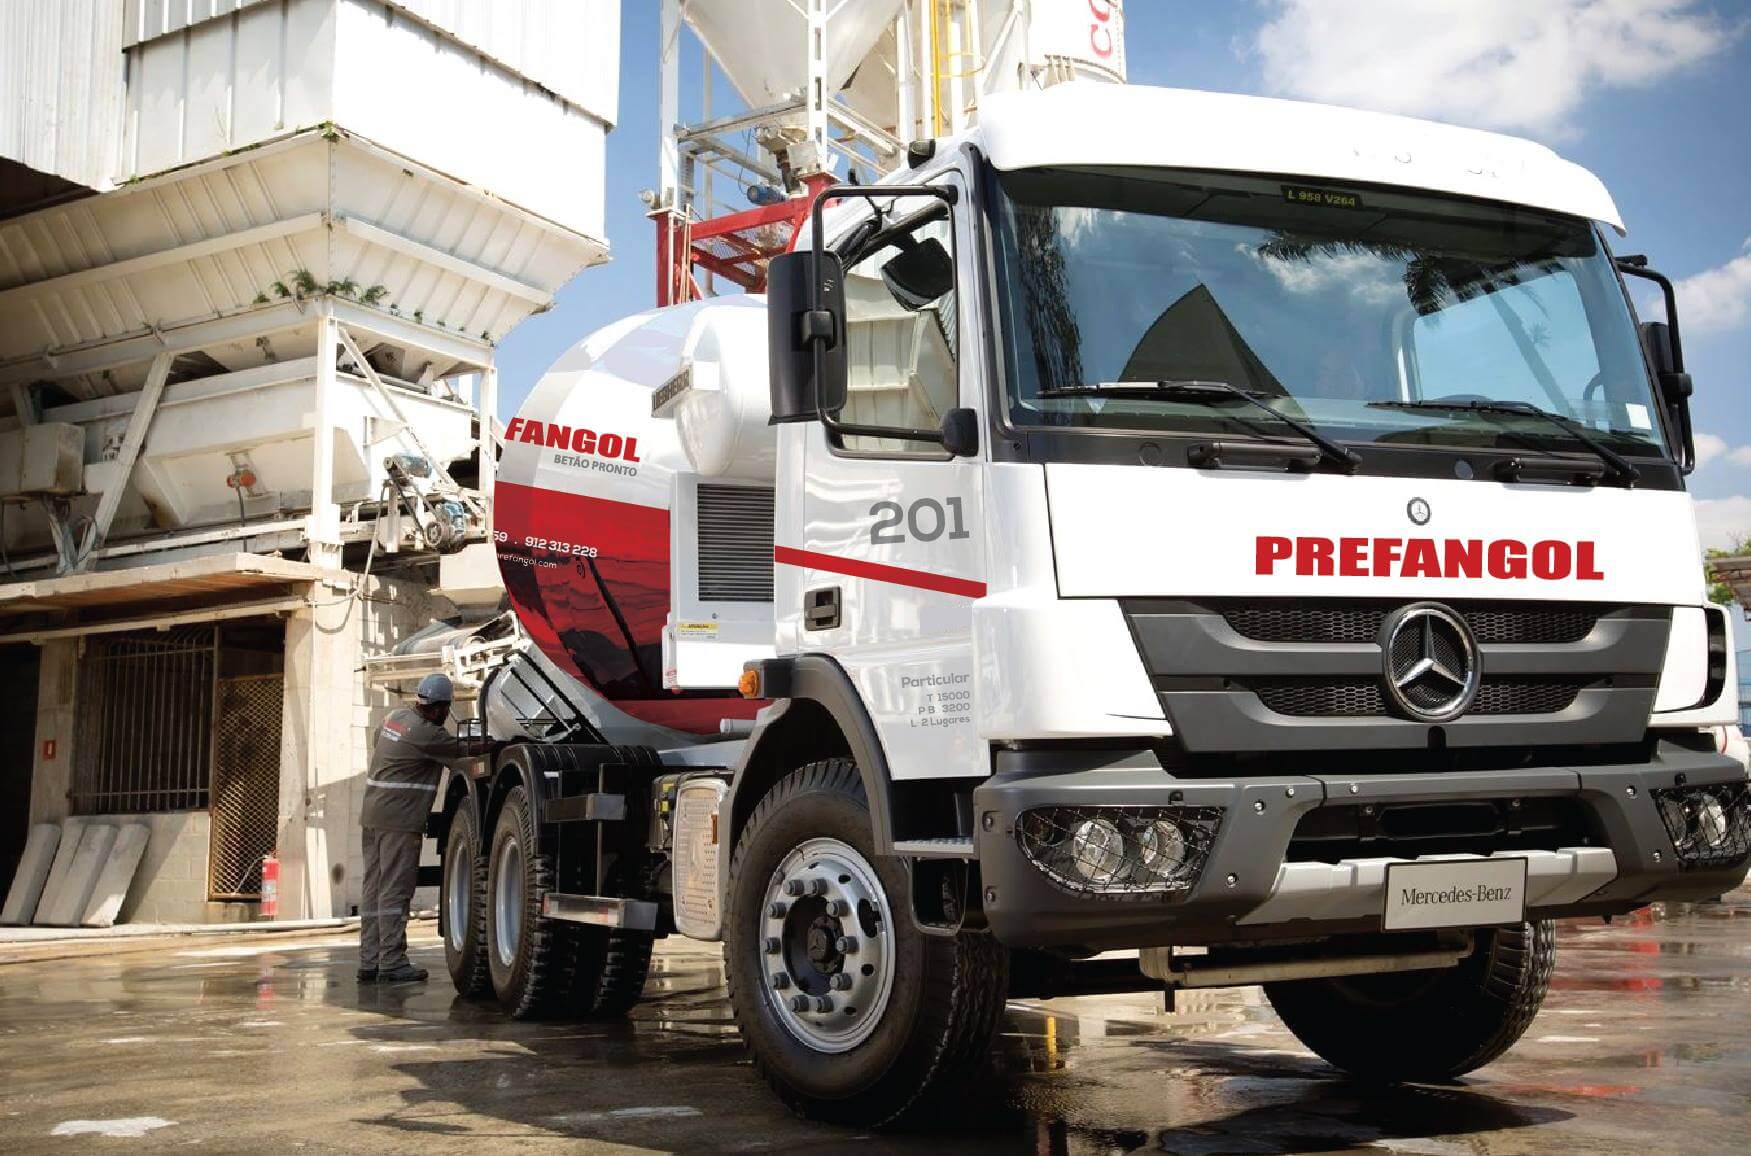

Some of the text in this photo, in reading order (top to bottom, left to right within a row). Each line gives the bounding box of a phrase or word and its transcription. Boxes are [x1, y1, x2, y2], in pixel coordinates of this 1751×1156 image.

[504, 417, 640, 462] FANGOL
[553, 453, 638, 477] BETÃO PRONTO
[869, 496, 970, 545] 201
[525, 536, 547, 549] 912
[548, 541, 570, 553] 313
[572, 545, 598, 558] 228
[1255, 536, 1605, 580] PREFANGOL
[901, 673, 970, 688] Particular
[937, 690, 970, 702] 15000
[942, 702, 970, 713] 3200
[930, 716, 970, 728] Lugares
[1401, 884, 1512, 905] Mercedes-Benz
